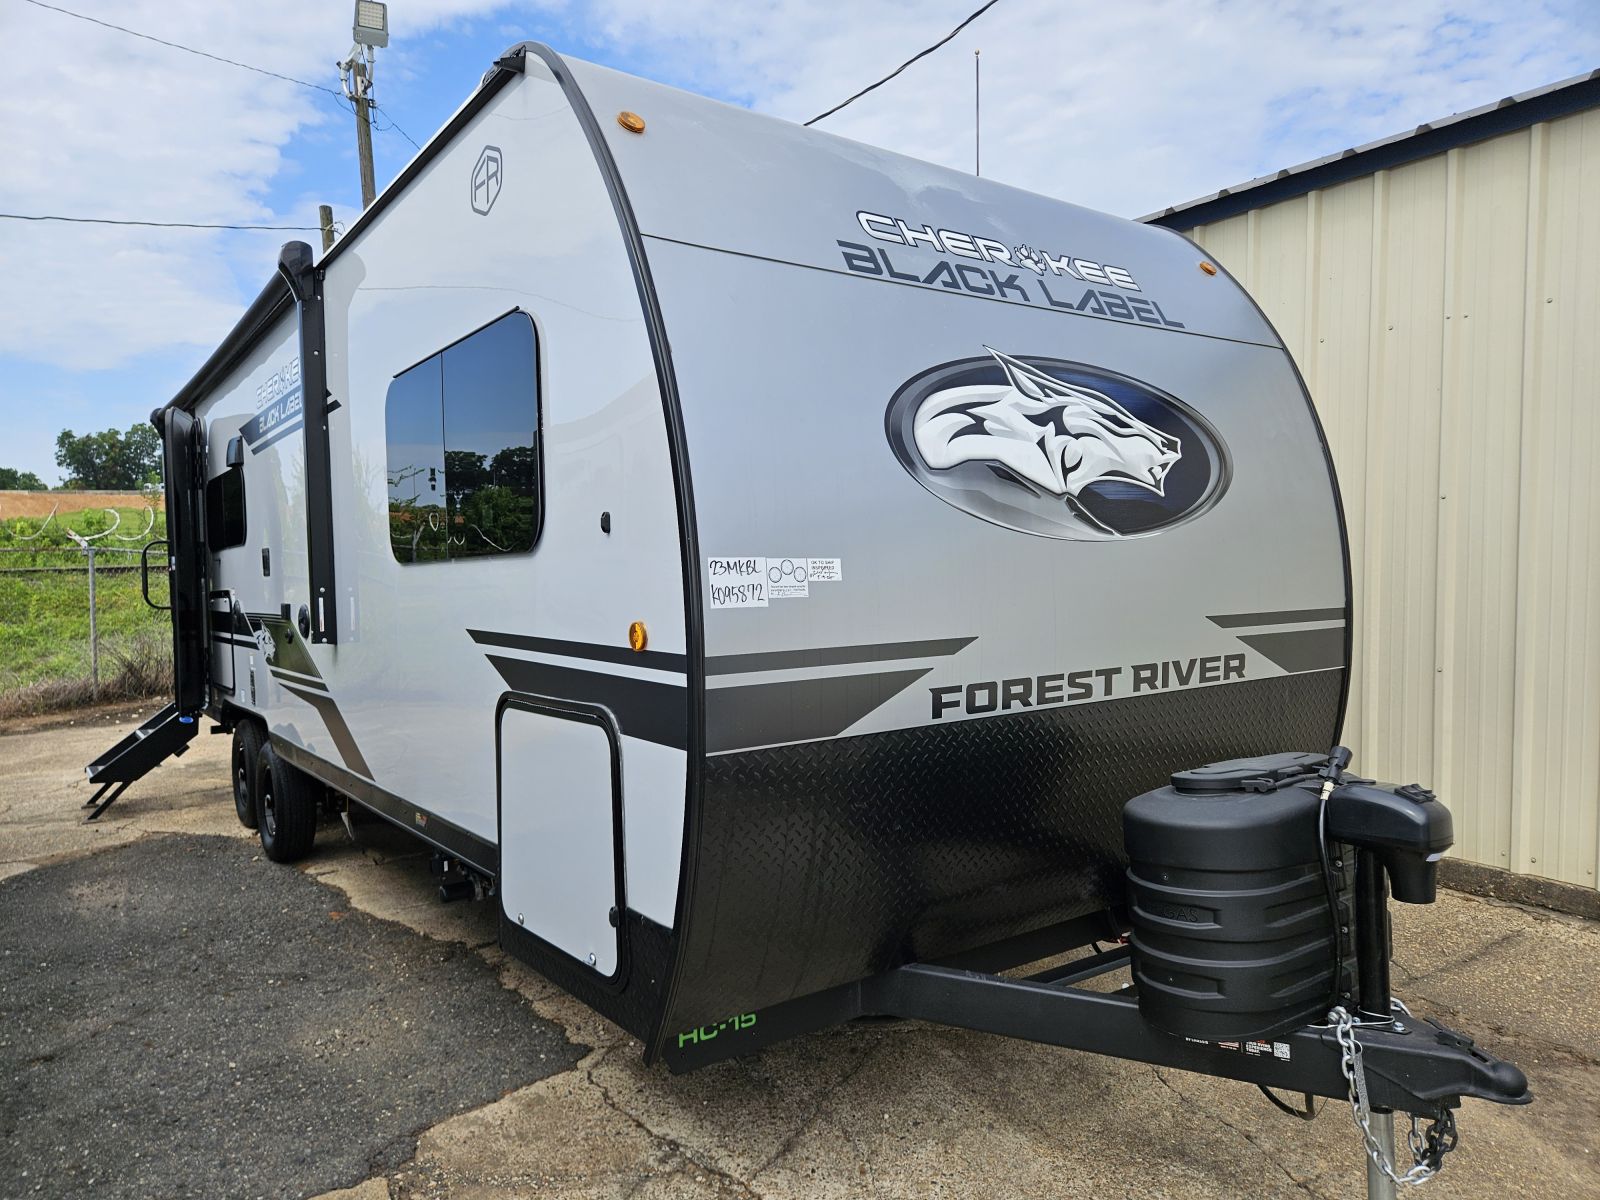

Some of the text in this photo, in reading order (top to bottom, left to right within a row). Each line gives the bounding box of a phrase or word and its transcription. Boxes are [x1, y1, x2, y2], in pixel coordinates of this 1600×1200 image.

[836, 240, 1186, 328] BLACK LABEL
[928, 653, 1246, 720] FOREST RIVER
